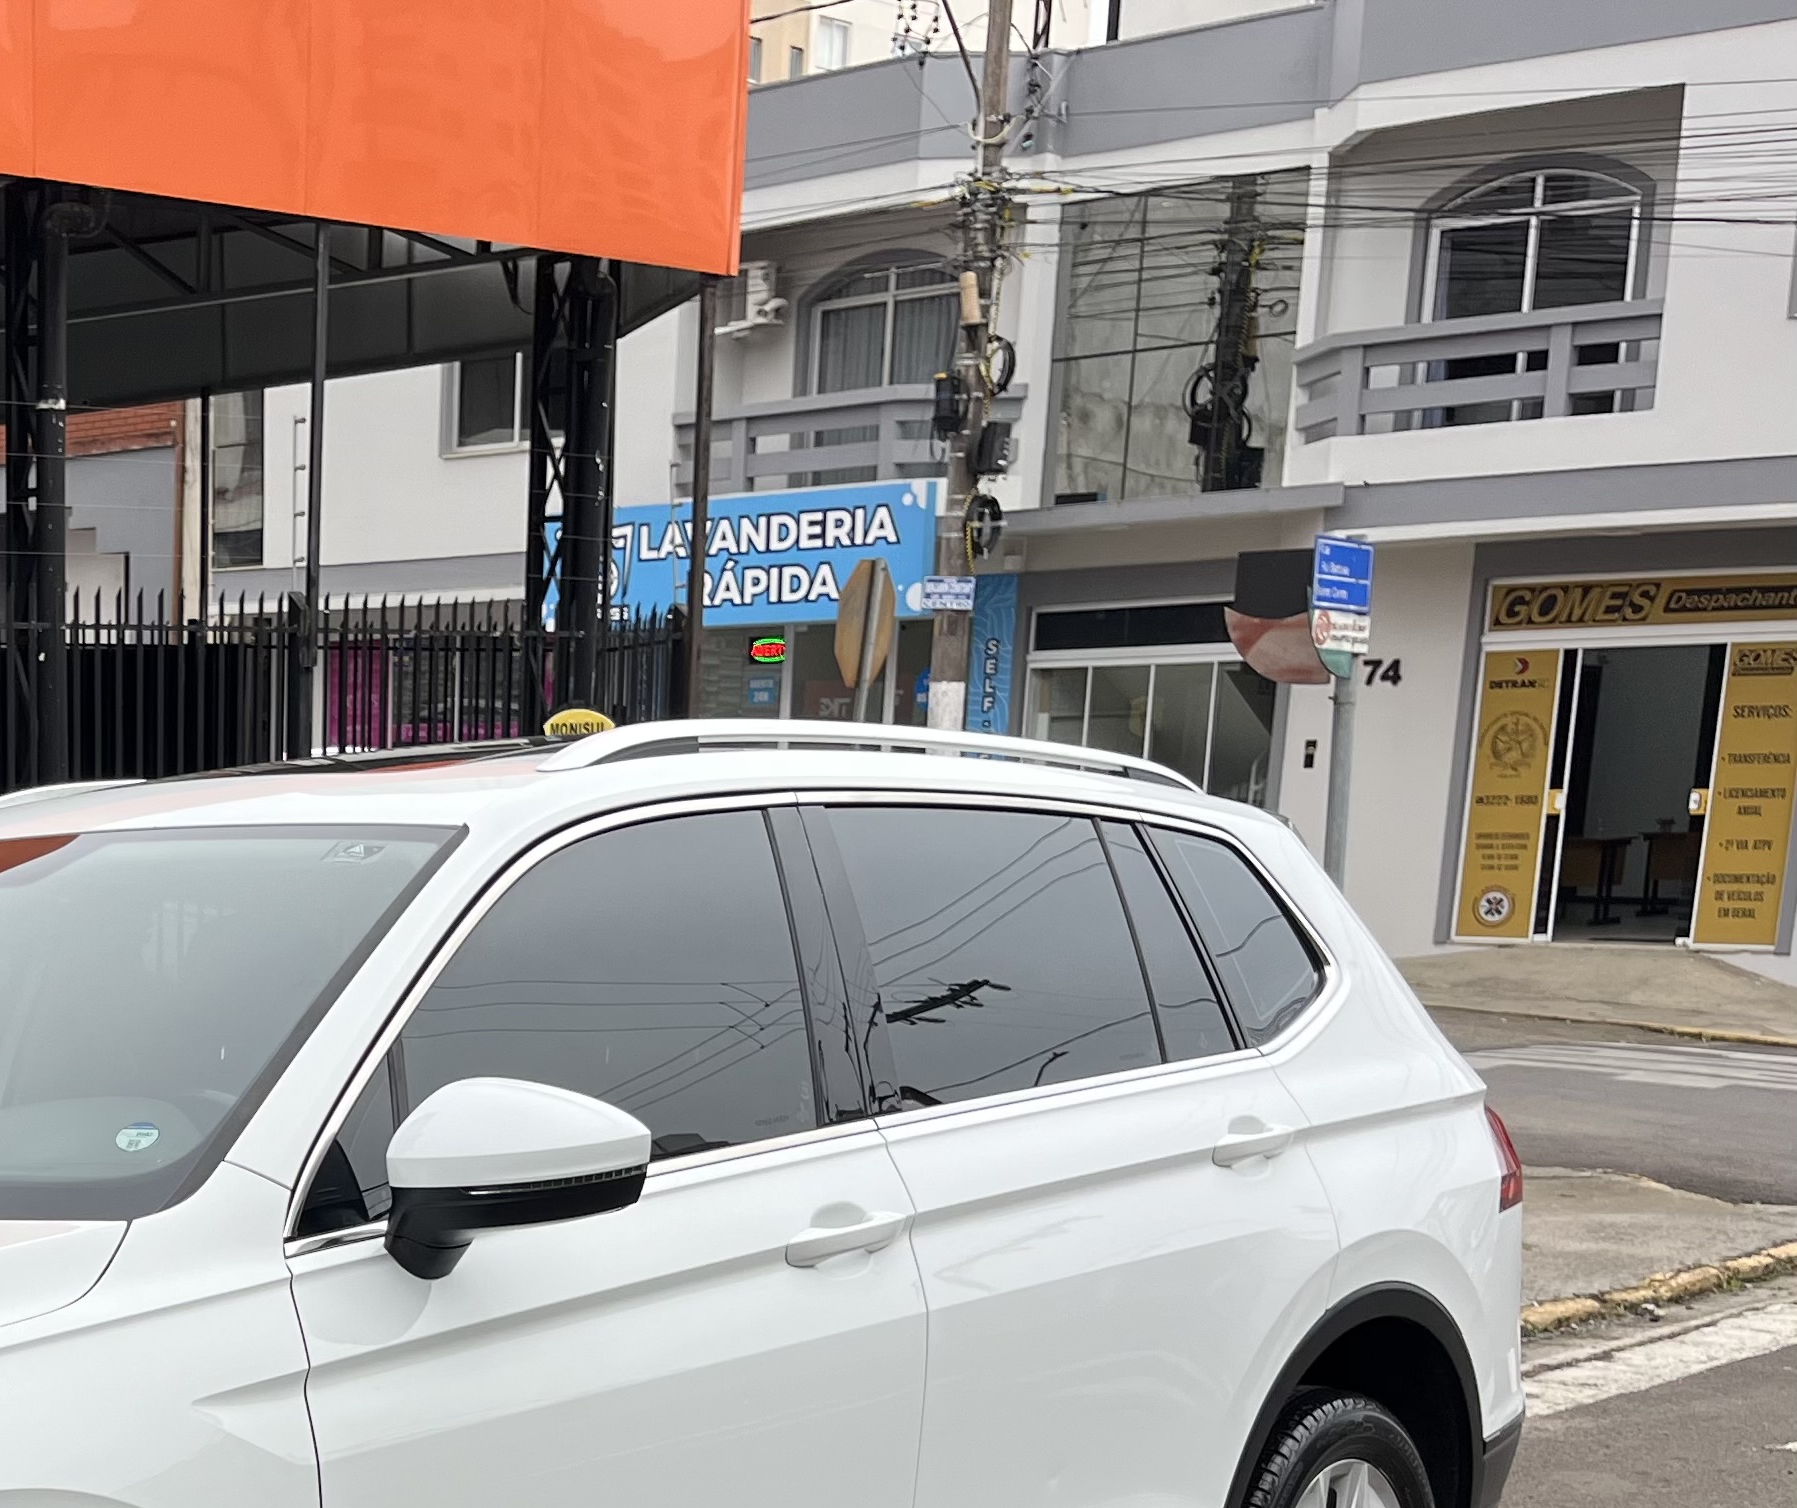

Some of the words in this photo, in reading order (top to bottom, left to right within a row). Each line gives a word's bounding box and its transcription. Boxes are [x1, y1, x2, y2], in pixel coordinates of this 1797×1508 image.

[1497, 583, 1659, 625] GOMES
[1668, 588, 1797, 611] Despachant
[1362, 658, 1402, 686] 74
